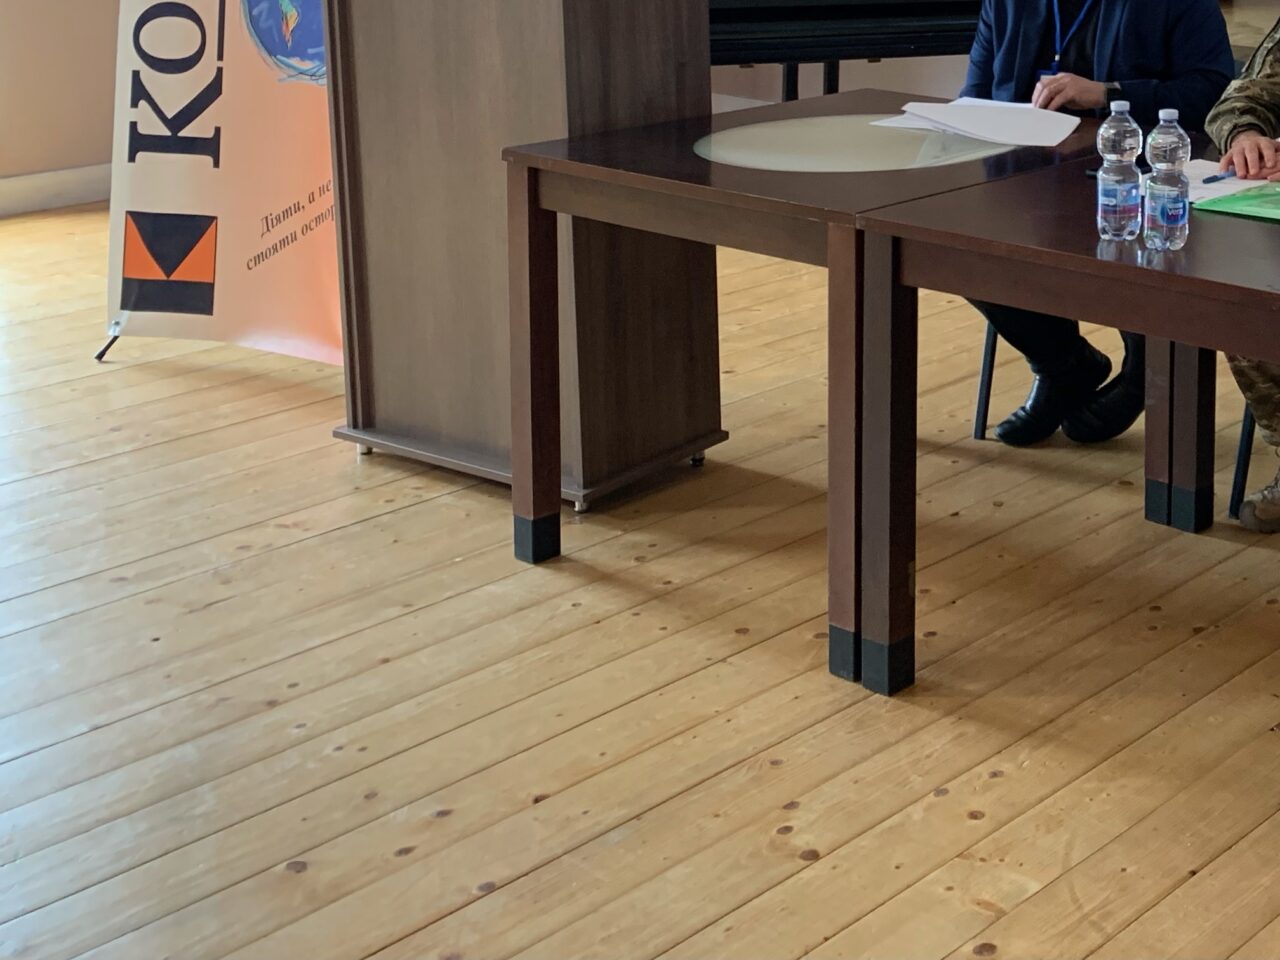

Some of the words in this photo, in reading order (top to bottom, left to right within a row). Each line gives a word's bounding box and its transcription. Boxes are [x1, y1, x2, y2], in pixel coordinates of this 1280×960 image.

[260, 200, 305, 238] Діяти,
[308, 191, 316, 205] а
[318, 178, 332, 198] не
[246, 230, 298, 271] стояти
